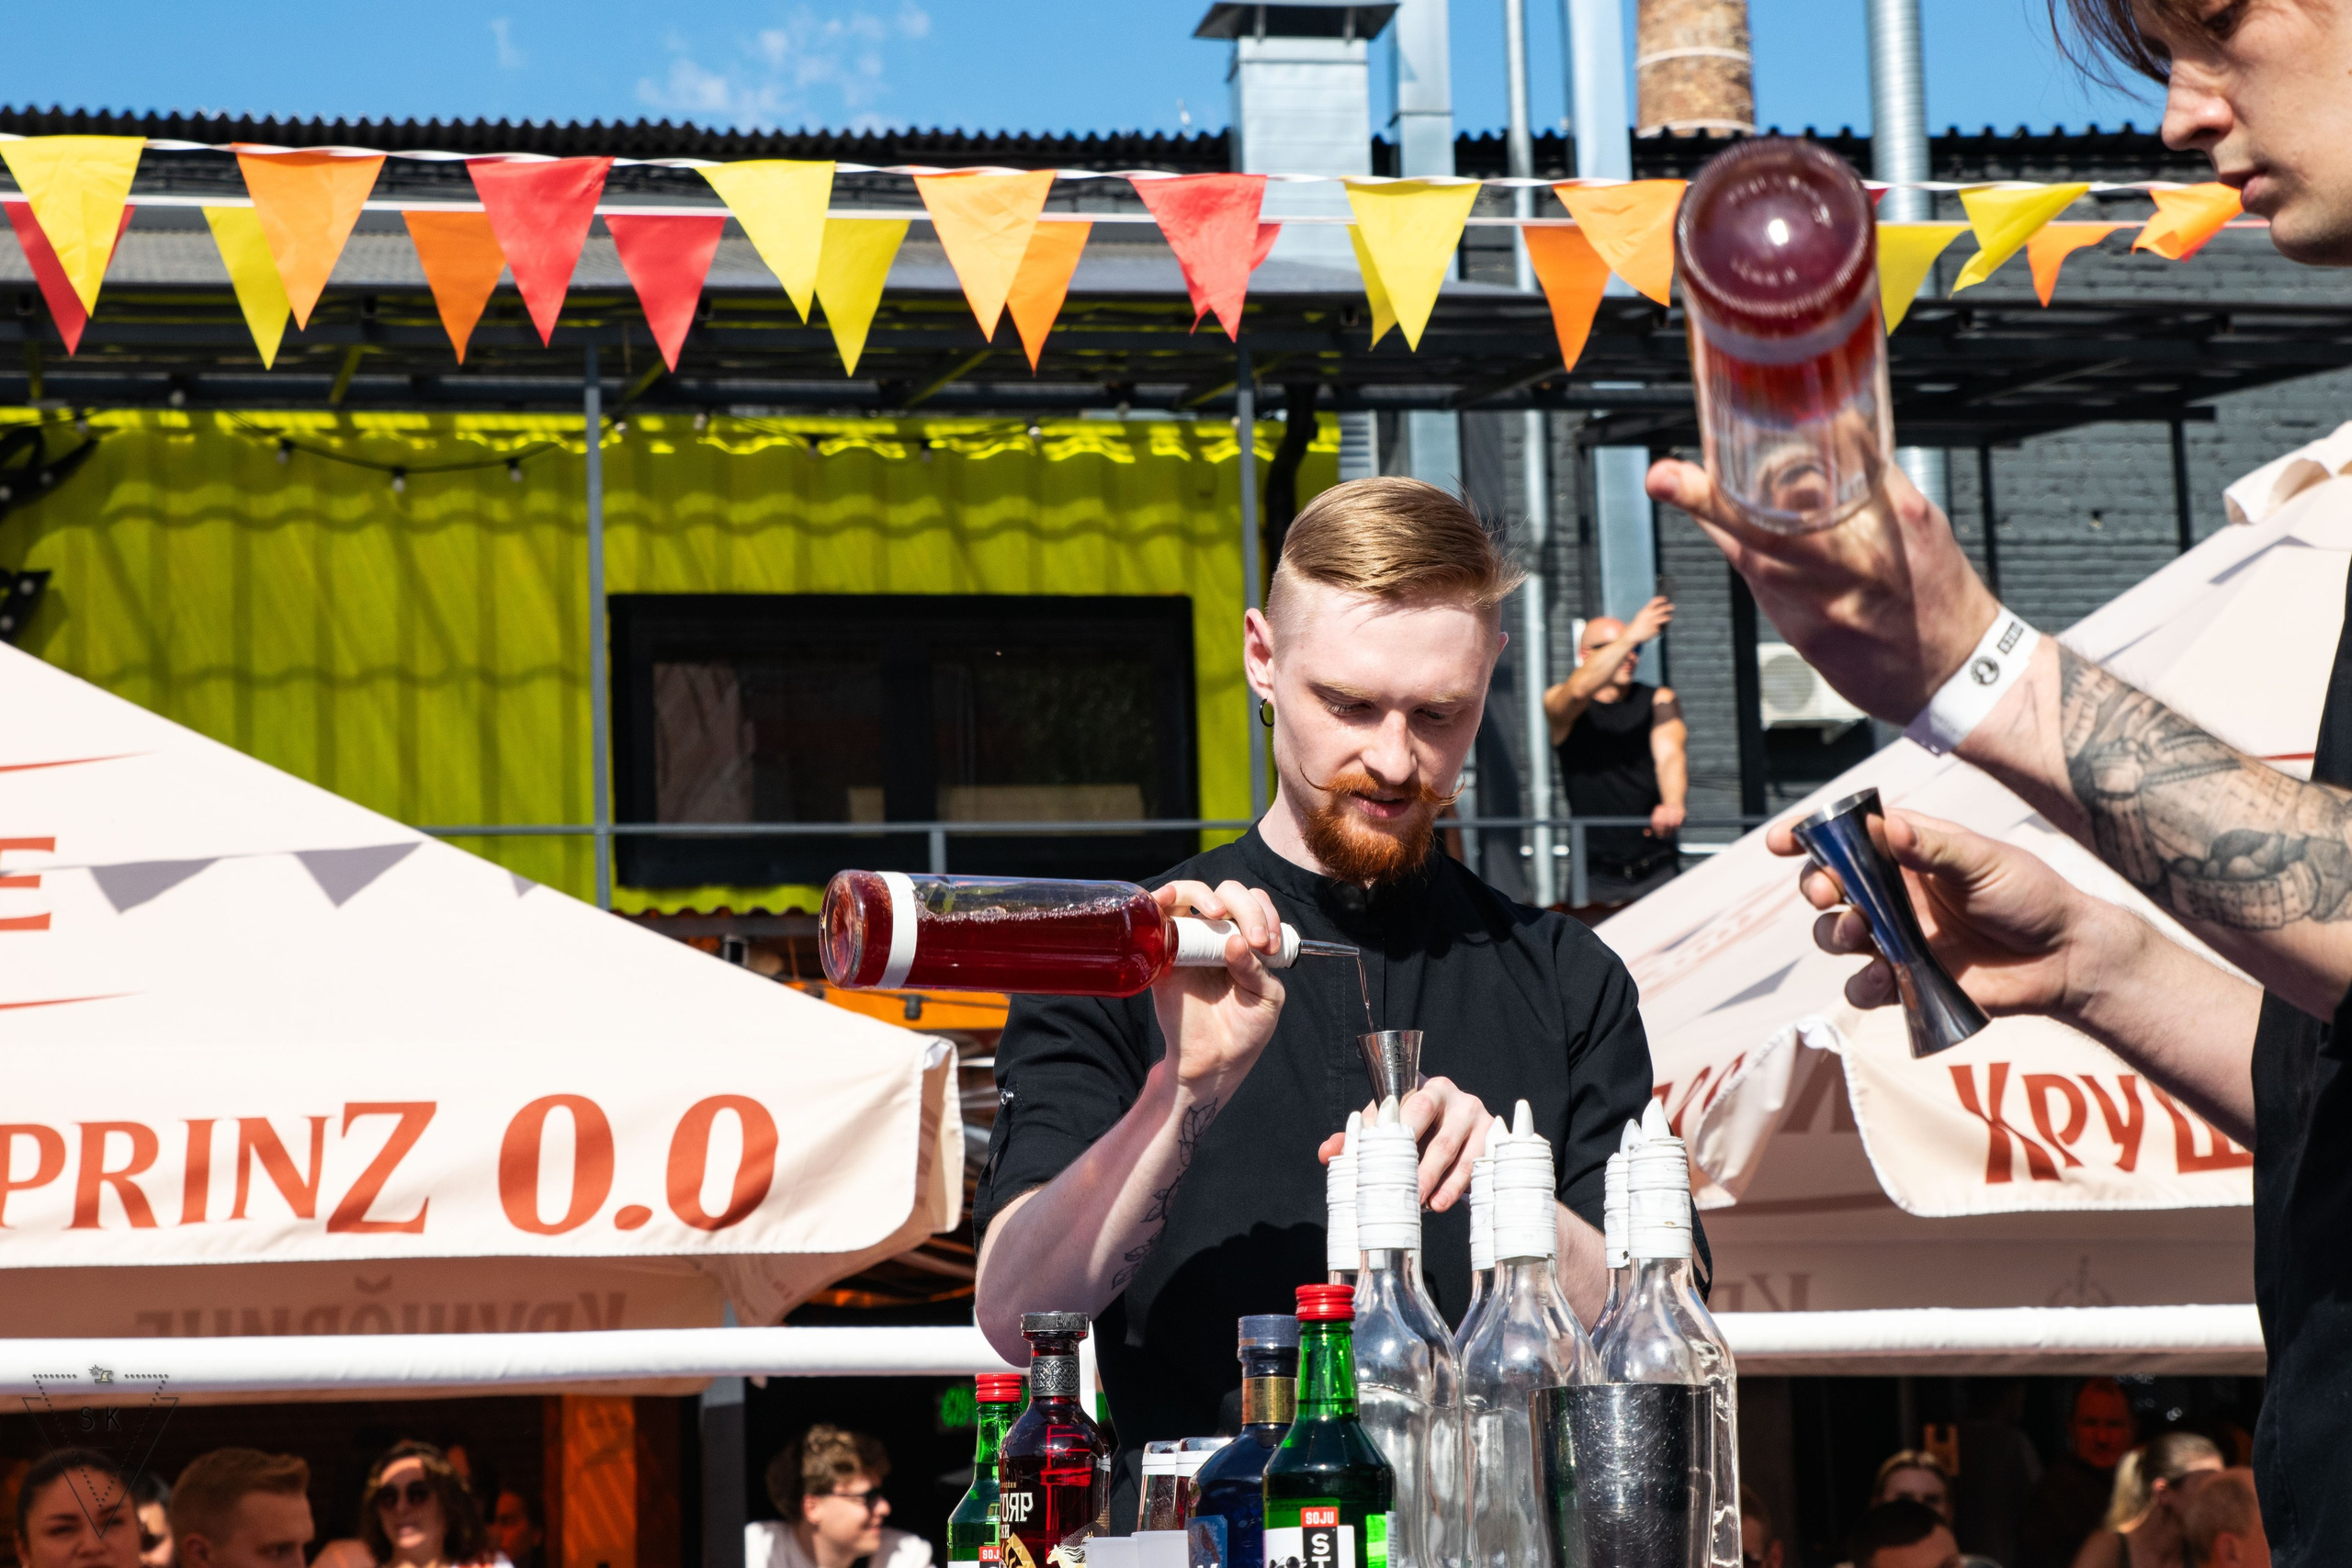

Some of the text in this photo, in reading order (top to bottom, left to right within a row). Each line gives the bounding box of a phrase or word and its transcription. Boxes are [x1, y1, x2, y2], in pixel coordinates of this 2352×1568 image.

[0, 1093, 779, 1235] PRINZ 0.0
[1306, 1511, 1334, 1525] SOJU
